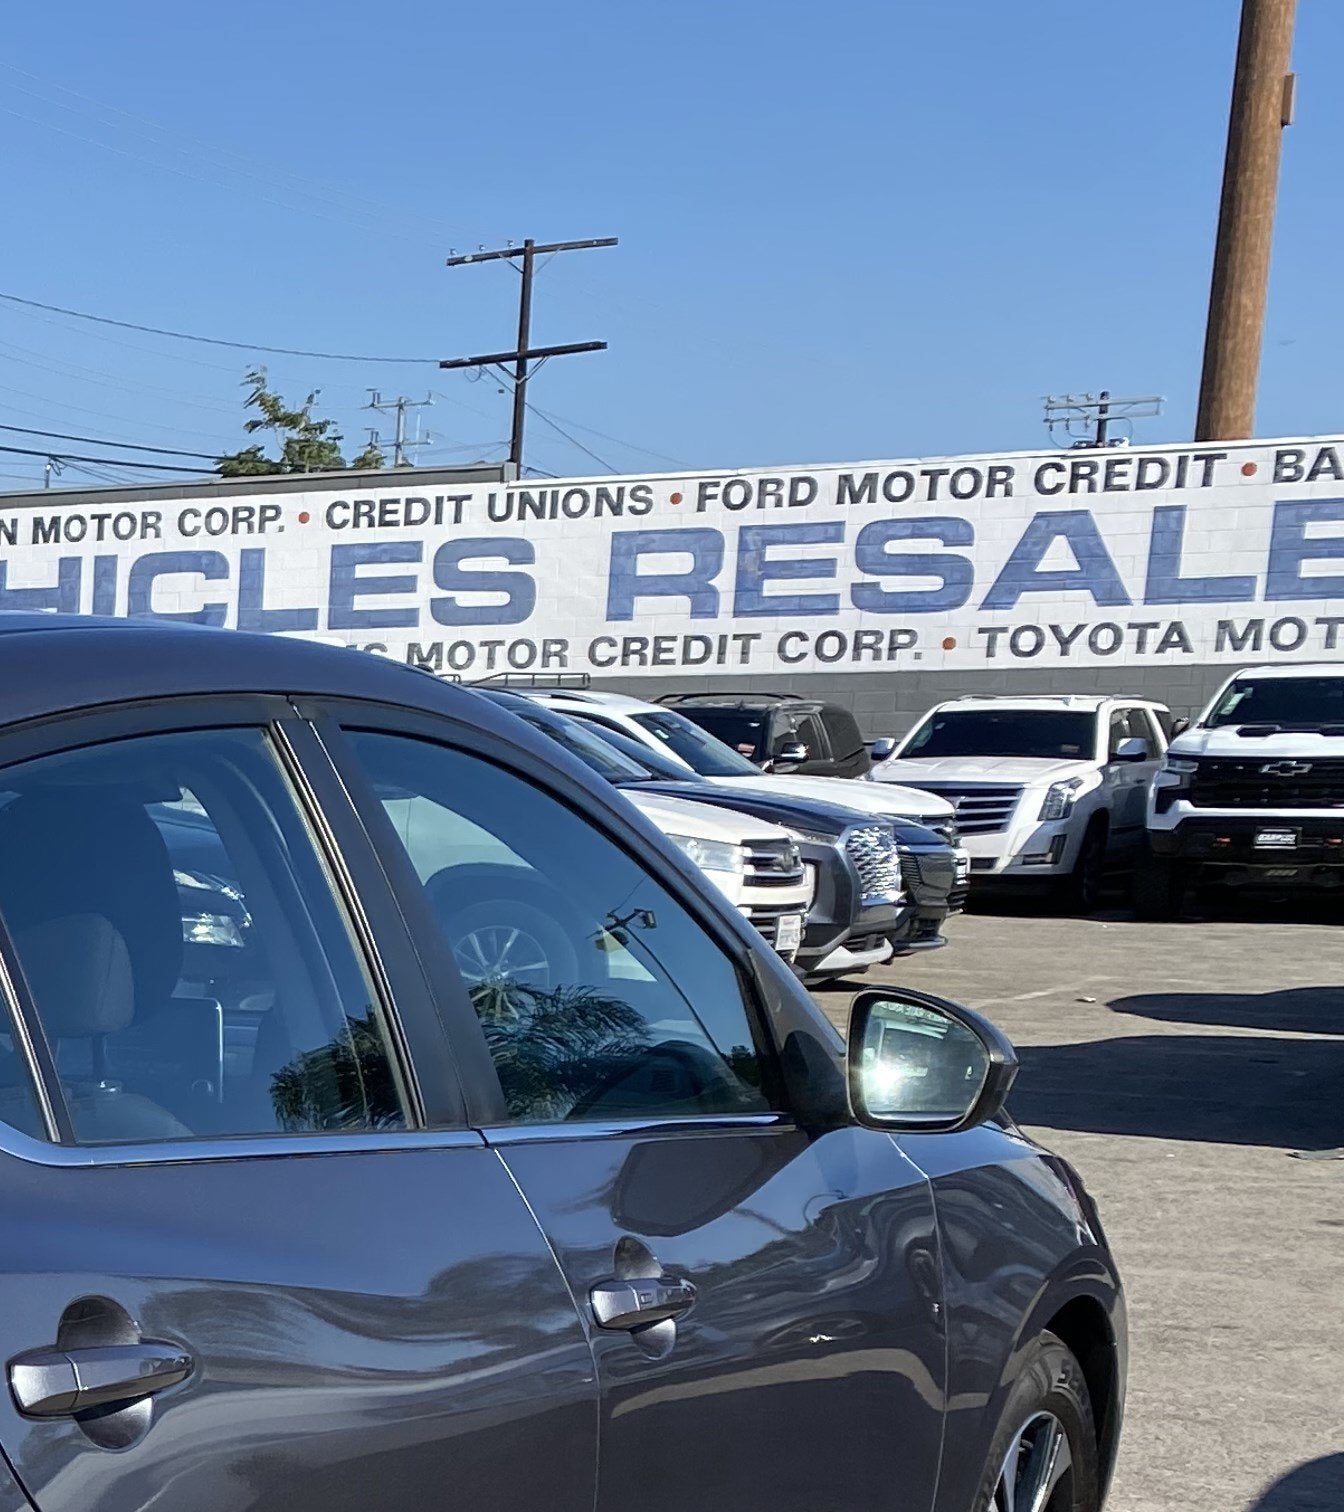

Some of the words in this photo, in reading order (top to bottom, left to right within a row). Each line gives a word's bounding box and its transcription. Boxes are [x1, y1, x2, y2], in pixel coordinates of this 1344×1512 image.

[31, 511, 163, 545] MOTOR
[178, 504, 285, 537] CORP.
[326, 494, 472, 530] CREDIT
[487, 484, 654, 522] UNIONS
[697, 475, 818, 513] FORD
[836, 465, 1016, 505] MOTOR
[1034, 453, 1228, 495] CREDIT
[406, 638, 570, 671] MOTOR
[588, 633, 761, 667] CREDIT
[777, 628, 923, 664] CORP.
[978, 620, 1194, 658] TOYOTA
[1215, 616, 1344, 652] MOT
